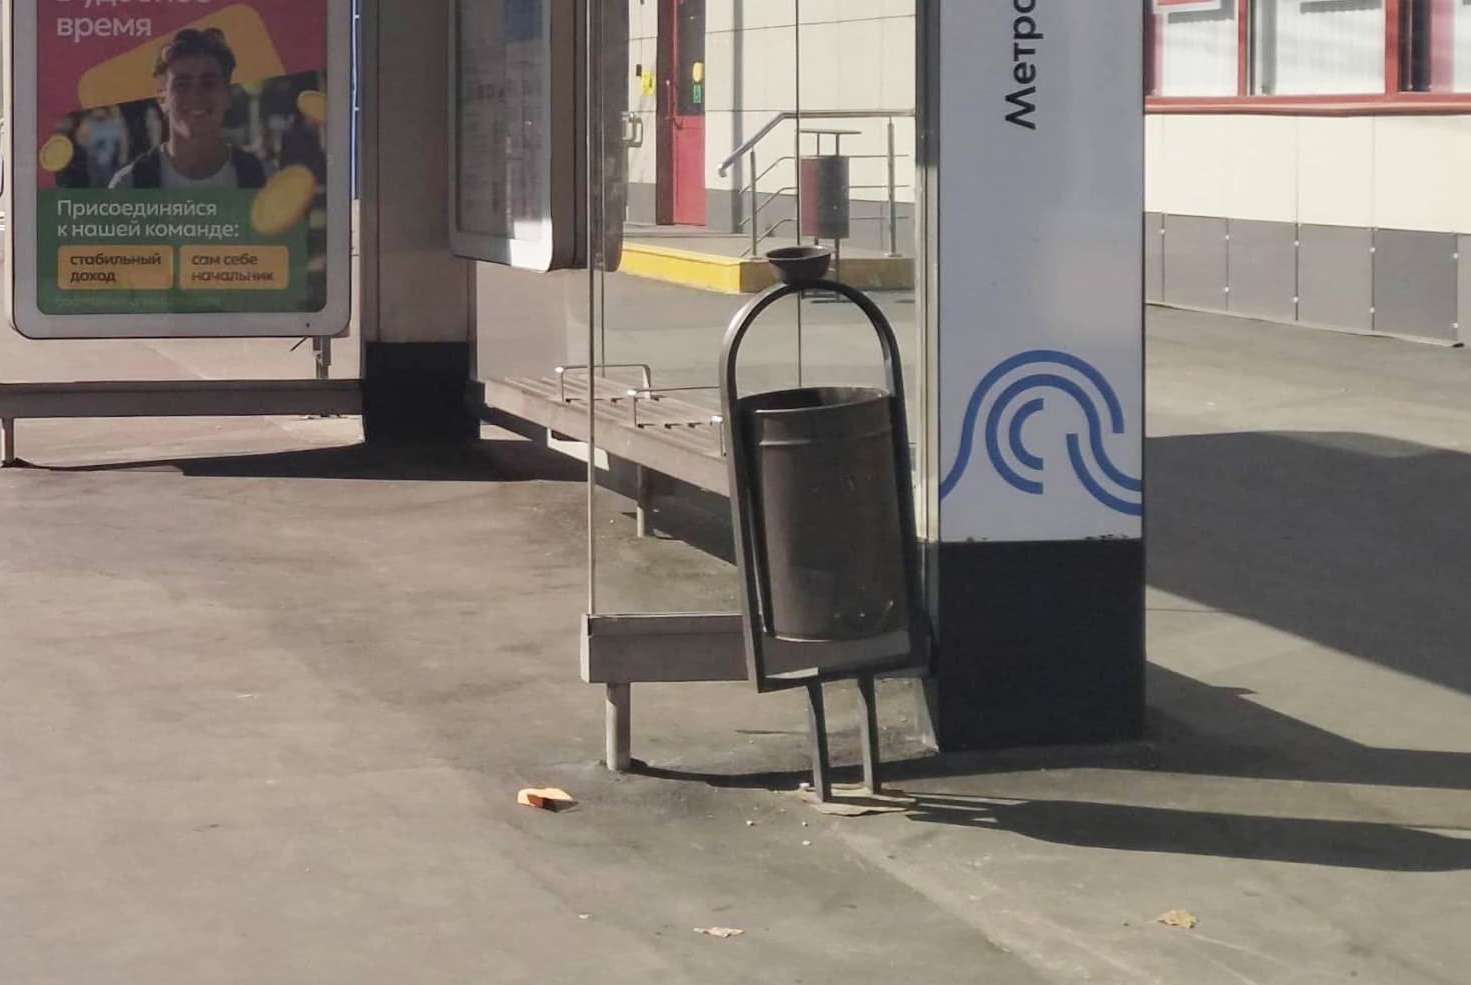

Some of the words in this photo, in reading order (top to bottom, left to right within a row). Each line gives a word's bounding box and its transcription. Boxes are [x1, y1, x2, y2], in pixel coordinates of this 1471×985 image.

[56, 17, 152, 44] время
[57, 199, 217, 218] Присоединяйся
[57, 224, 68, 238] к
[72, 220, 140, 238] нашей
[145, 223, 240, 240] команде:
[69, 252, 162, 266] стабильный
[191, 254, 221, 266] сам
[223, 252, 258, 266] себе
[69, 270, 117, 284] доход
[191, 271, 274, 282] начальник
